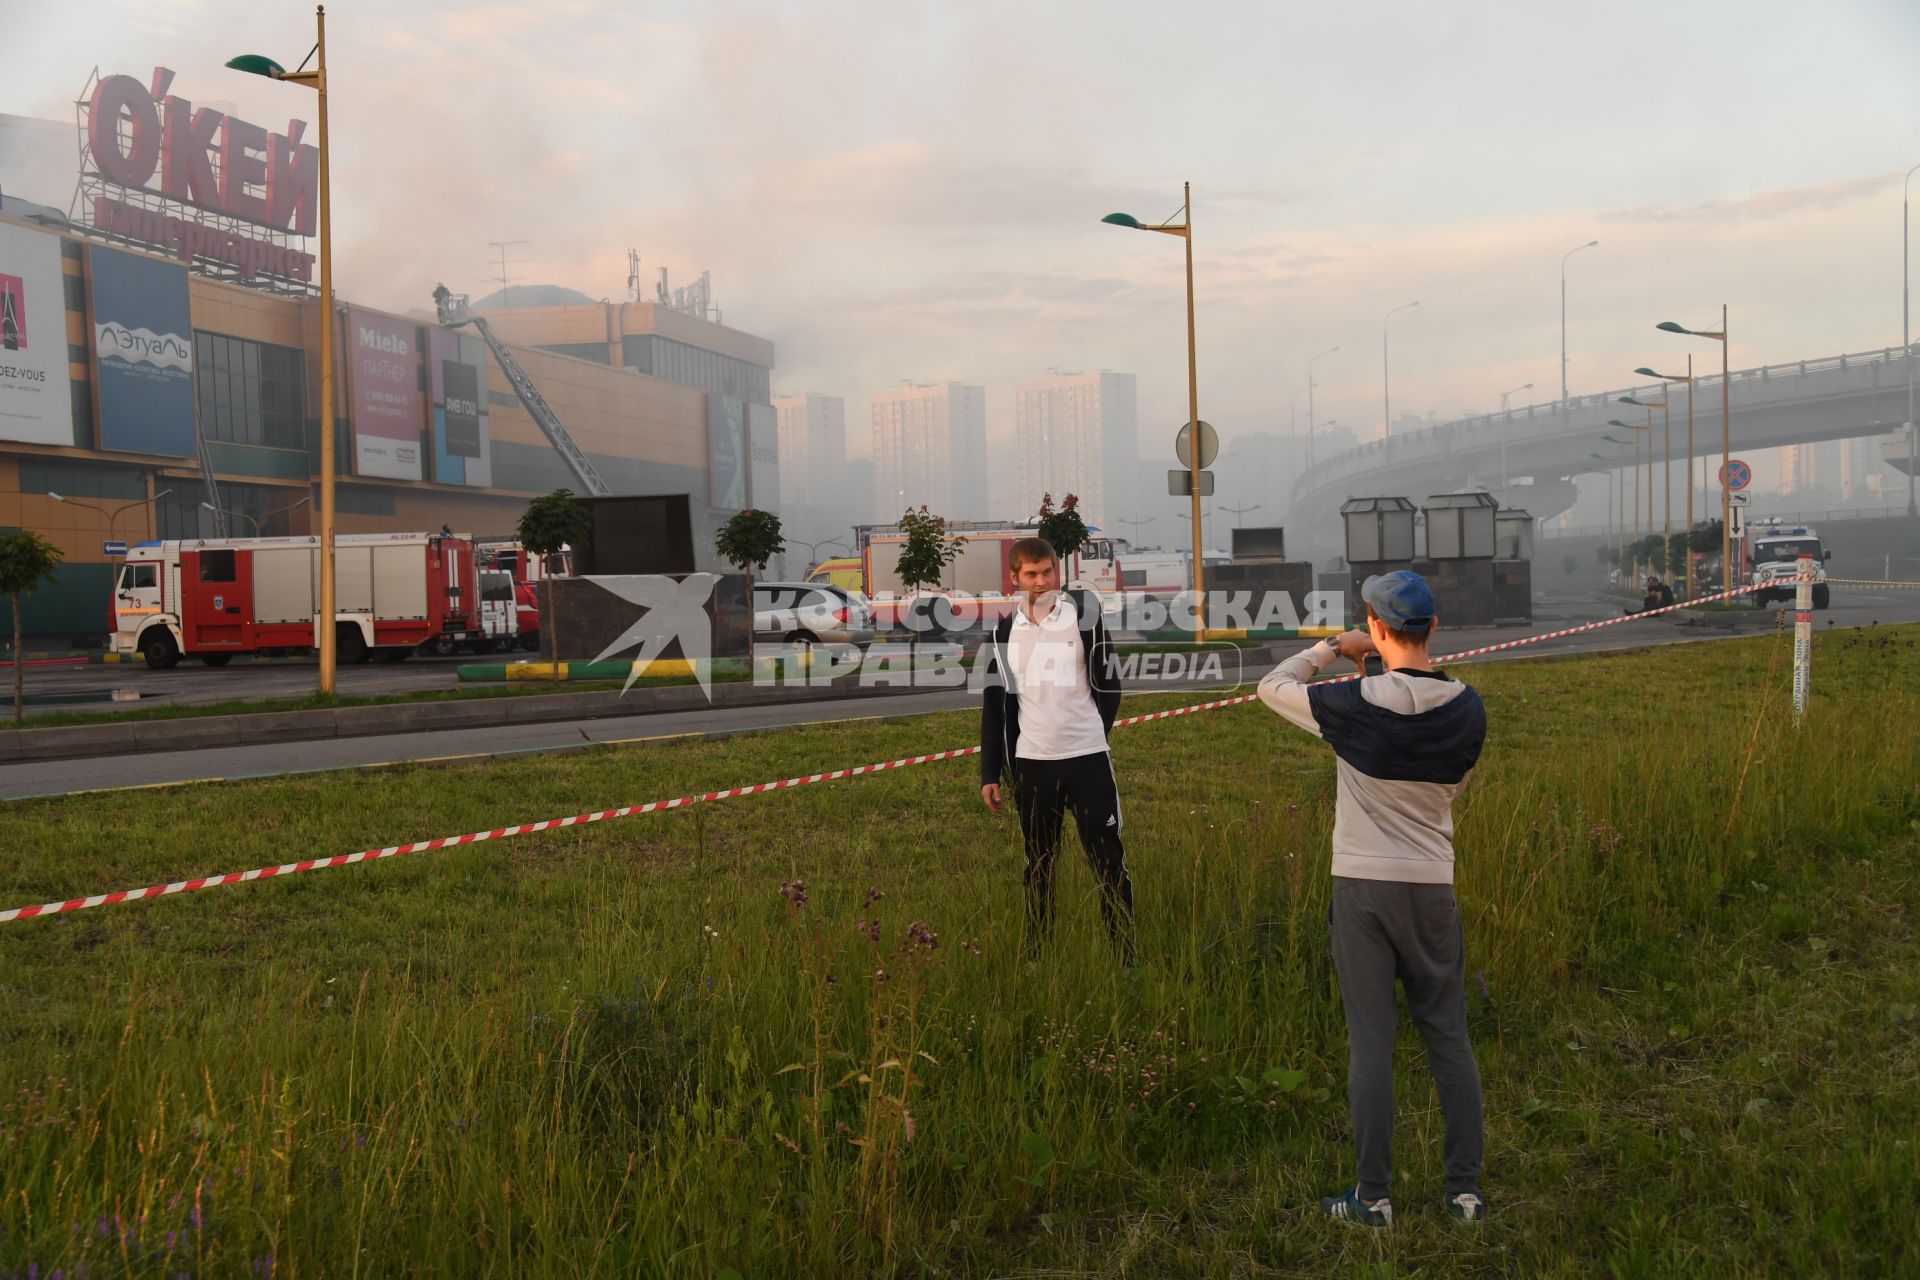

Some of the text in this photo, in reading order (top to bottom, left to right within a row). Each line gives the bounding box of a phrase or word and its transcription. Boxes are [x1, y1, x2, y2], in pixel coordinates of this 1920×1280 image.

[359, 327, 408, 355] Miele
[1101, 568, 1110, 576] 39
[129, 597, 142, 609] 73
